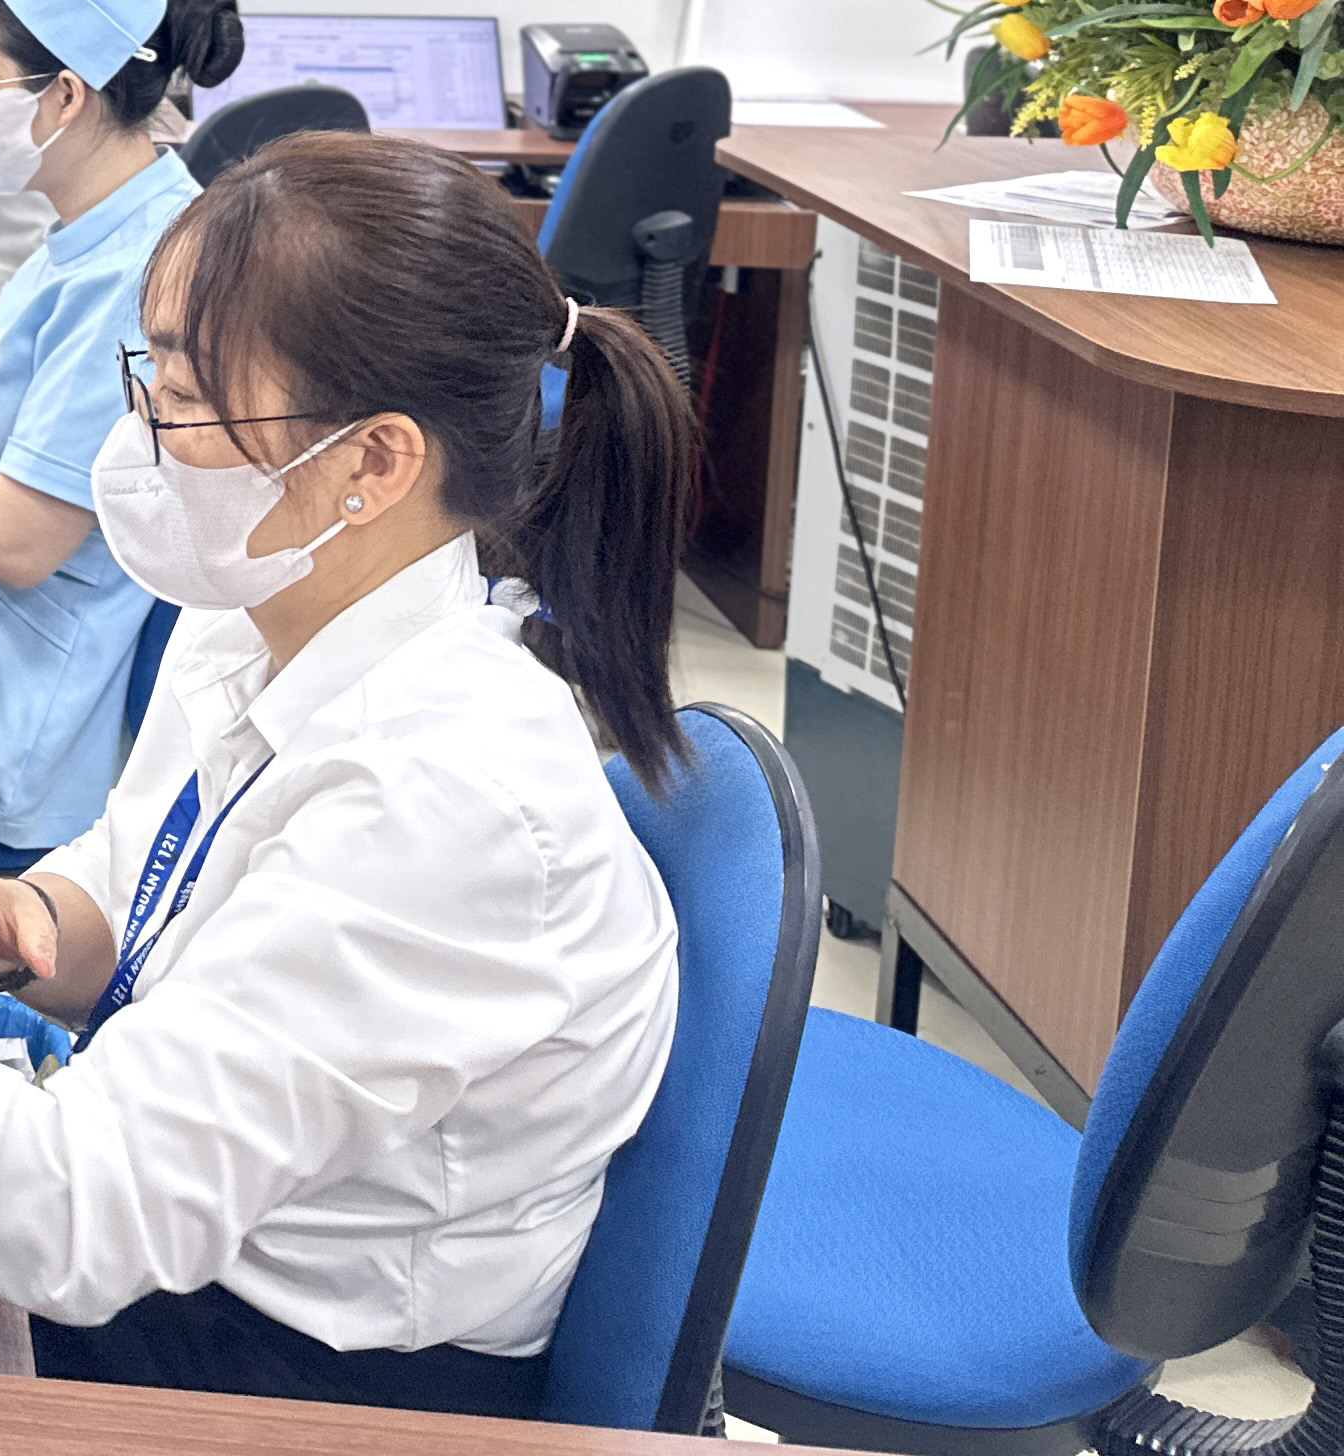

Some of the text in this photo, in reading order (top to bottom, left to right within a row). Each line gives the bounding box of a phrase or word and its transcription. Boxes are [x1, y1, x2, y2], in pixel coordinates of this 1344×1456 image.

[157, 833, 179, 858] 121
[152, 859, 165, 871] Y
[135, 872, 160, 917] QUÂN
[111, 983, 128, 1005] 121
